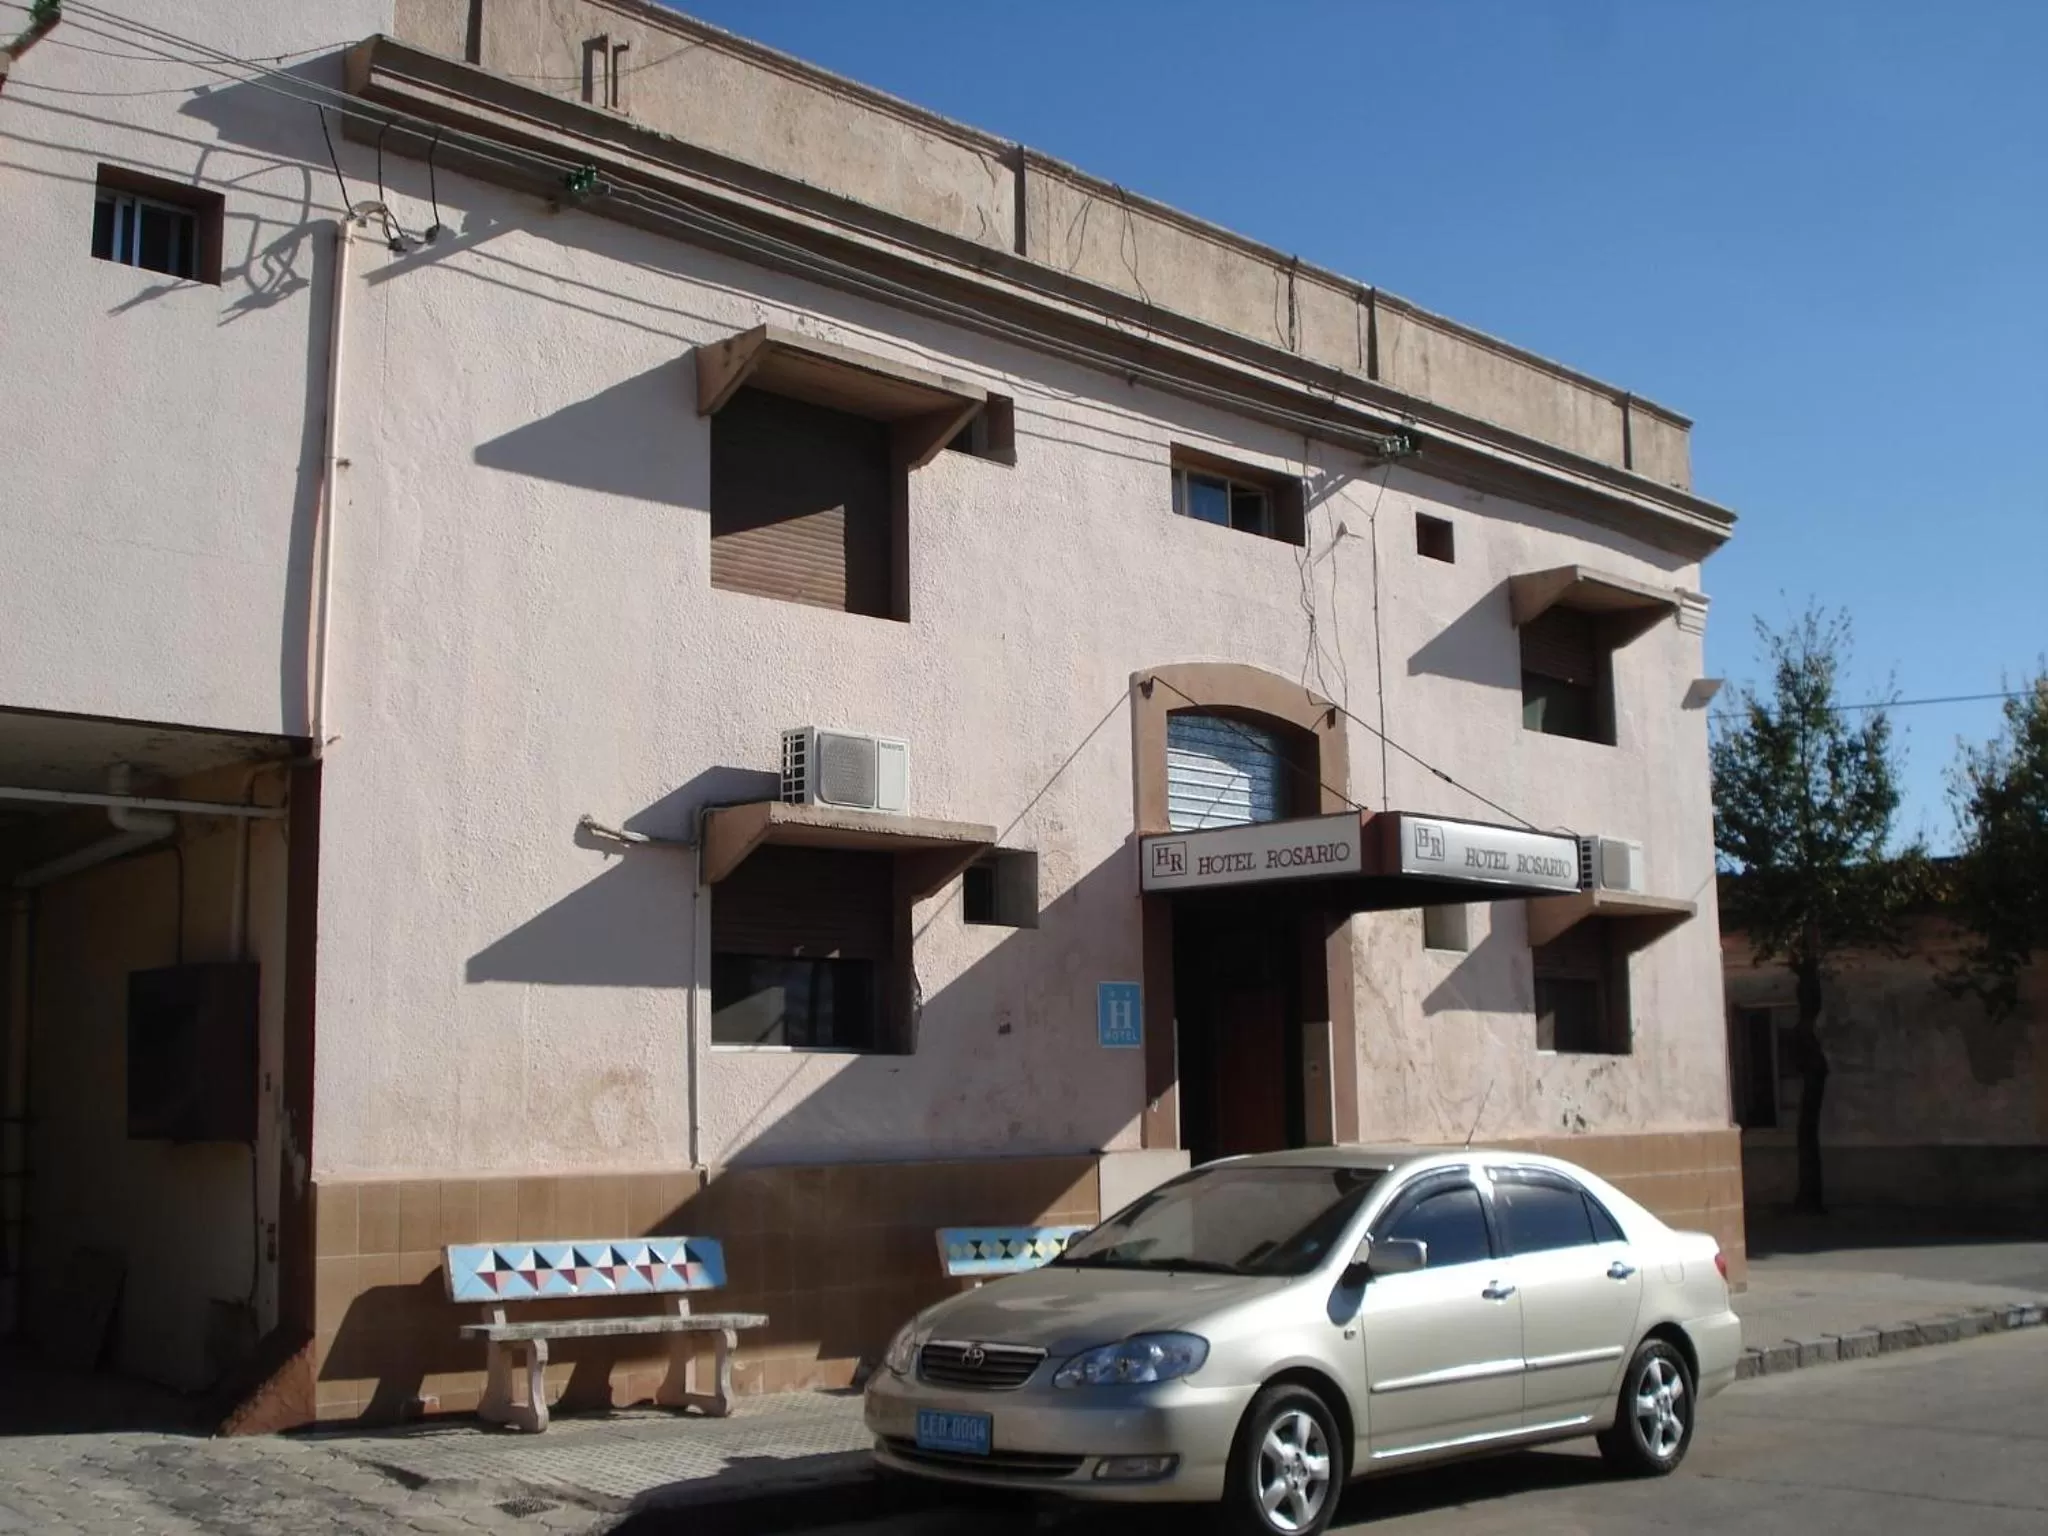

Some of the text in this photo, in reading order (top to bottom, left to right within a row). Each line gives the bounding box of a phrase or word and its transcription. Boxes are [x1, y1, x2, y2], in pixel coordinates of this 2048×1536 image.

[1197, 842, 1351, 875] HOTEL ROSARIO
[1464, 847, 1573, 880] HOTEL ROSARIO
